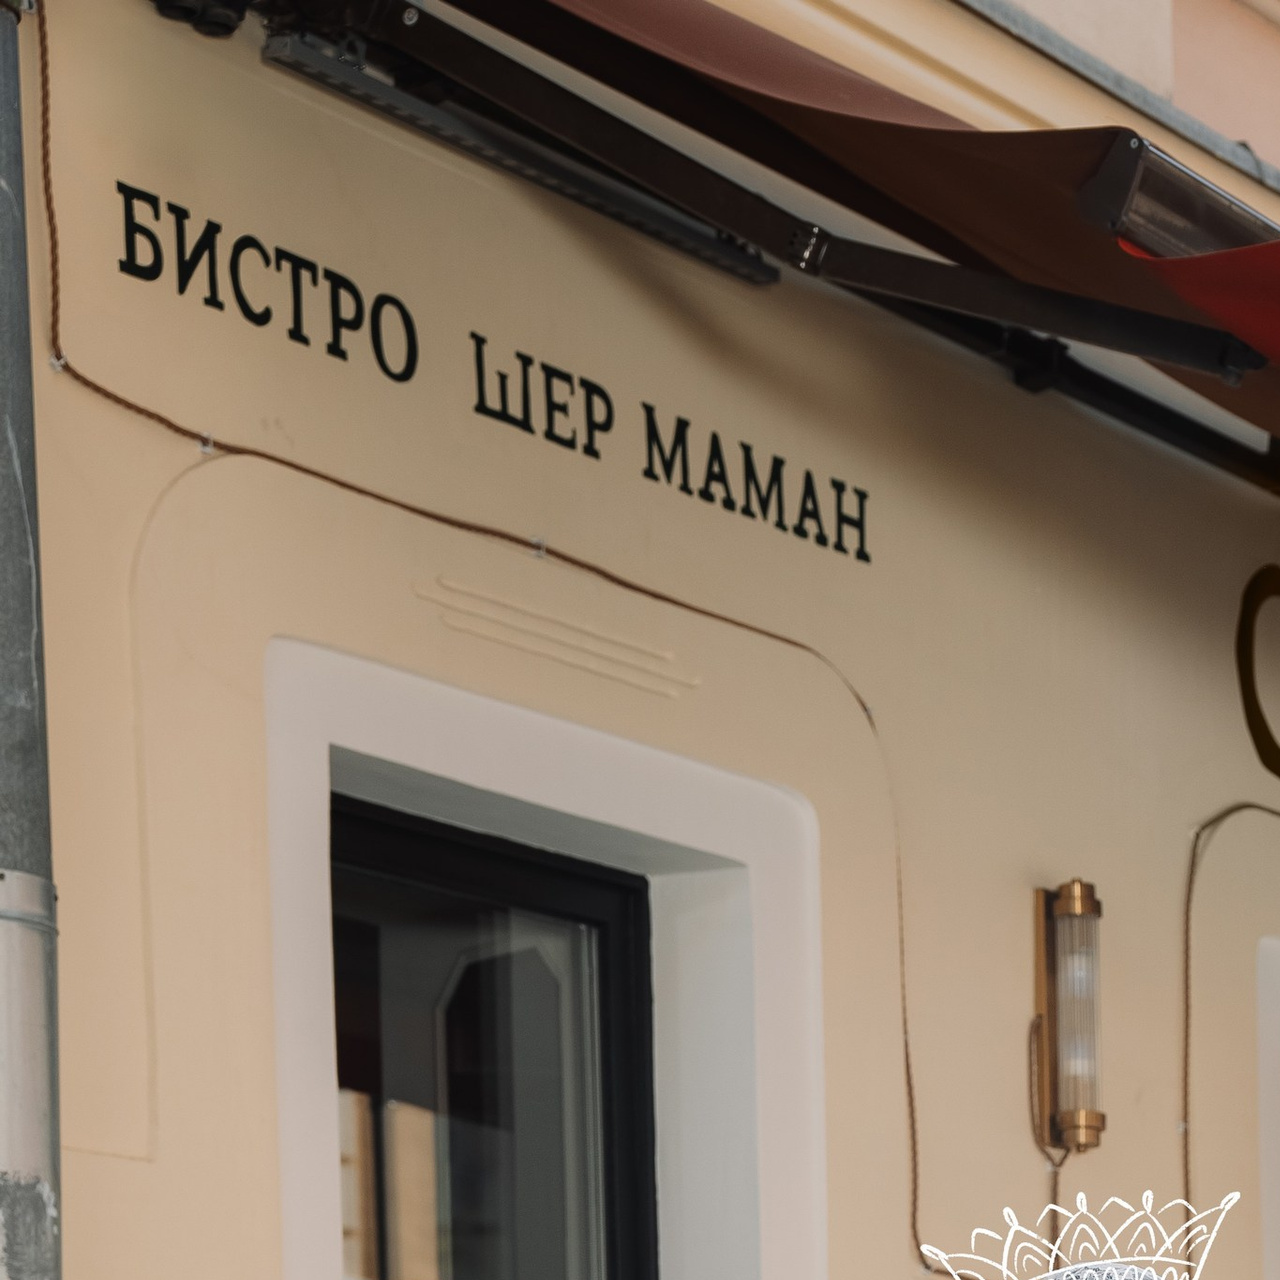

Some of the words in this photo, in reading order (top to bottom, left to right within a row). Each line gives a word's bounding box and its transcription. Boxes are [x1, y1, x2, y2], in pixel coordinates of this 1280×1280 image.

[116, 179, 420, 384] БИСТРО
[470, 331, 615, 461] ШЕР
[641, 401, 871, 563] МАМАН
